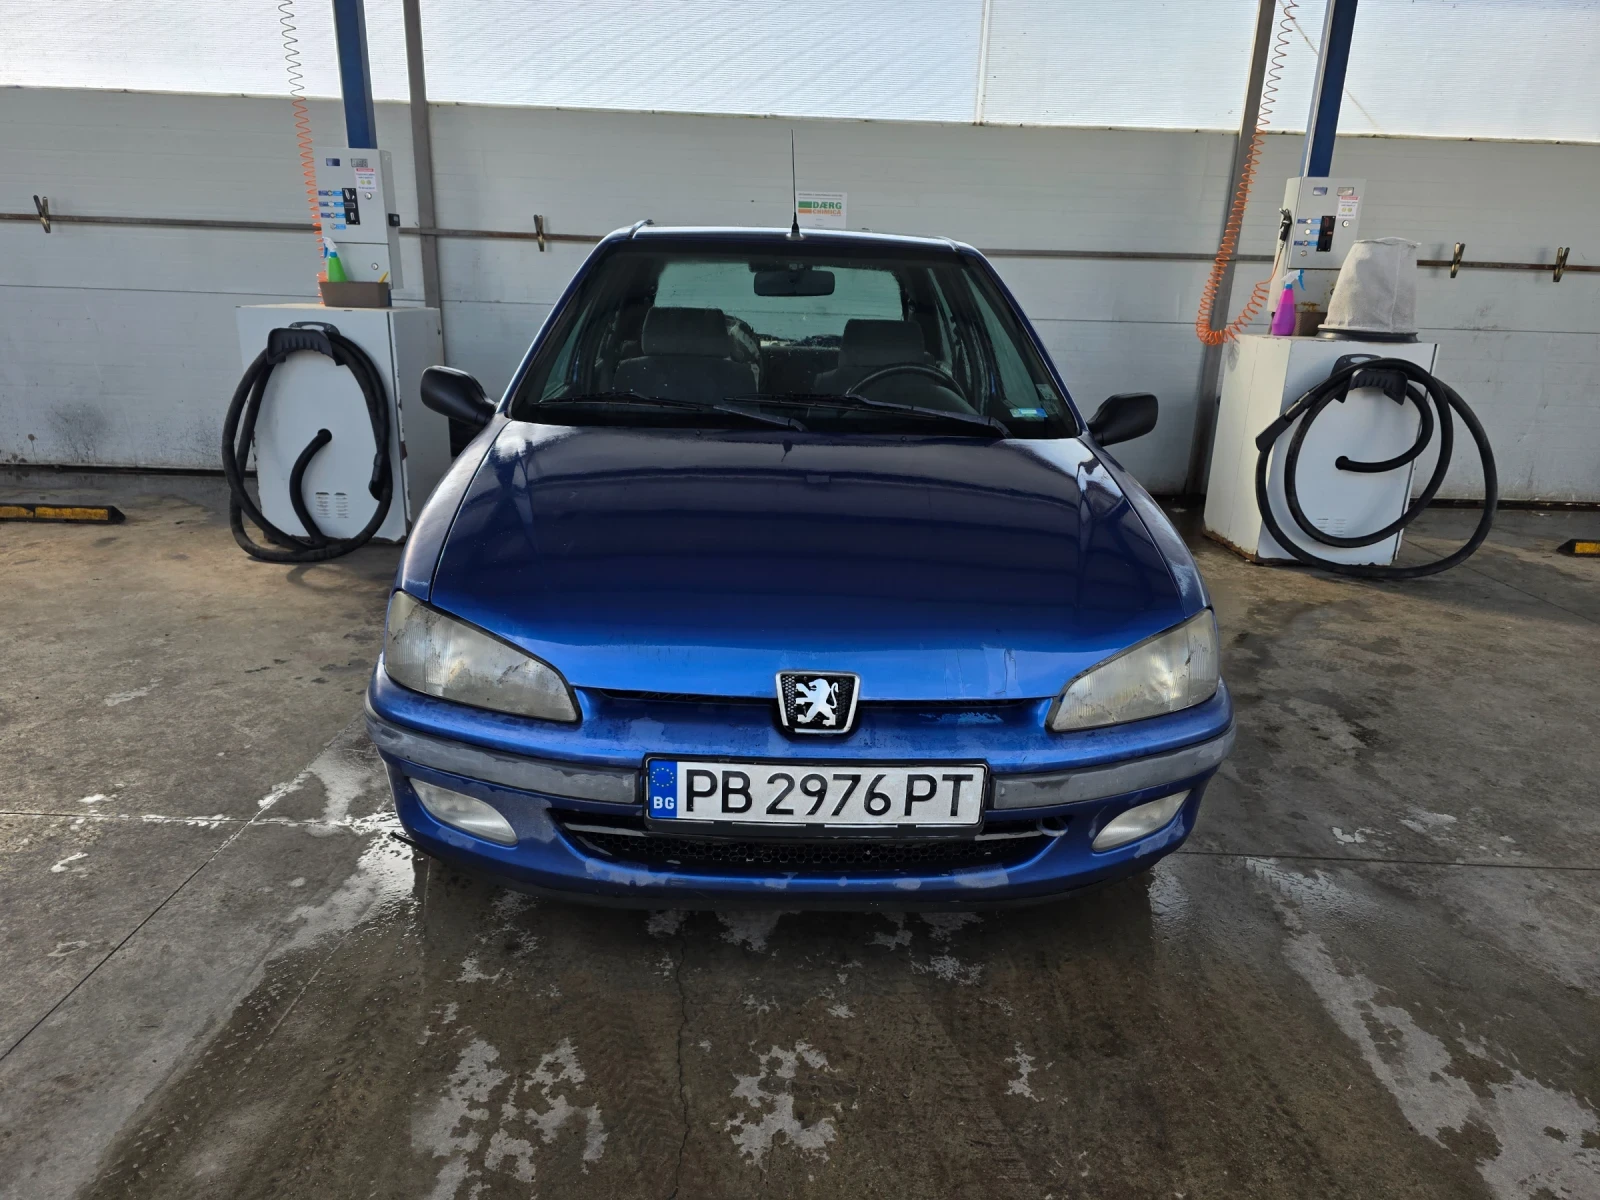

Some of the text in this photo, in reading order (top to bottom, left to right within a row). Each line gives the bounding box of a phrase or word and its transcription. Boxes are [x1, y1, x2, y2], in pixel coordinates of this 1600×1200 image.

[812, 201, 842, 209] DÆRG
[686, 769, 974, 817] PB 2976 PT
[653, 796, 675, 809] BG
